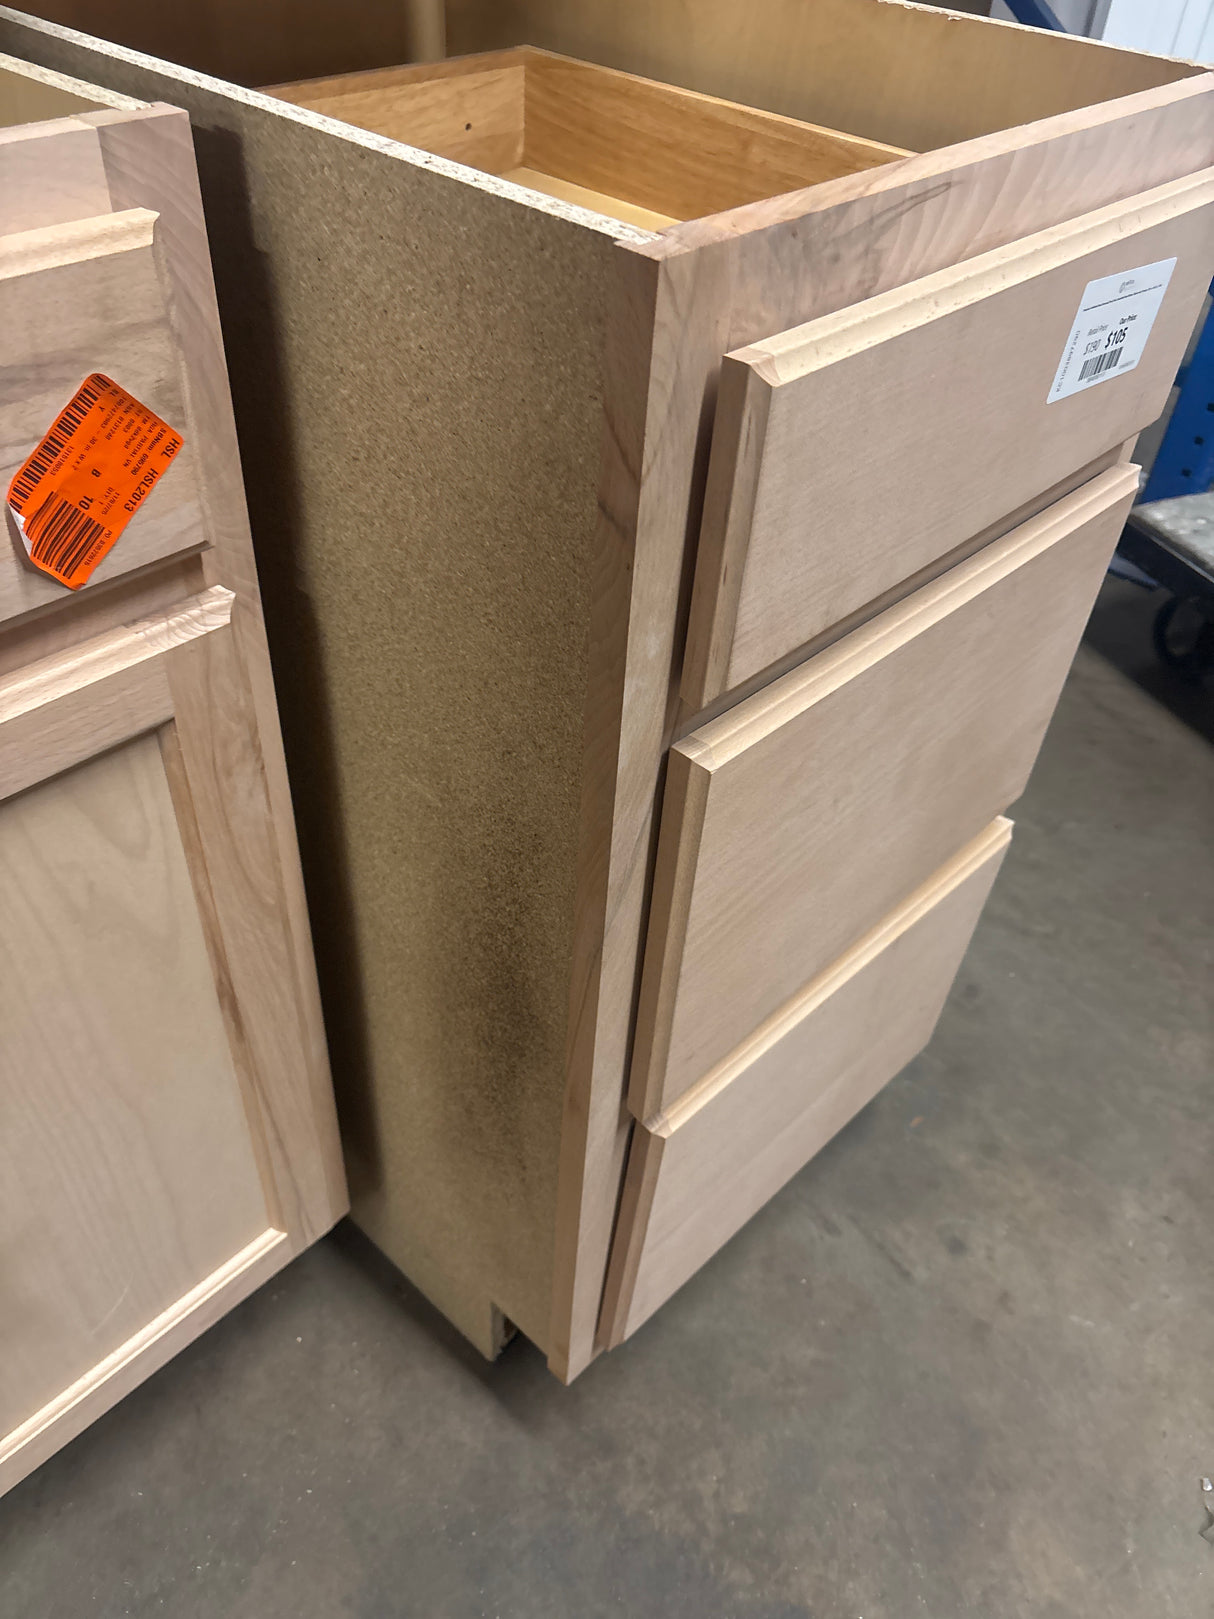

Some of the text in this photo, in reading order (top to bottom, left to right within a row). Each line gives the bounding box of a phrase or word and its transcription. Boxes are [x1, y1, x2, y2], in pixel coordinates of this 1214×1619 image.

[1104, 326, 1129, 350] $105
[123, 437, 180, 514] HSL HSL2013
[77, 492, 94, 511] 10
